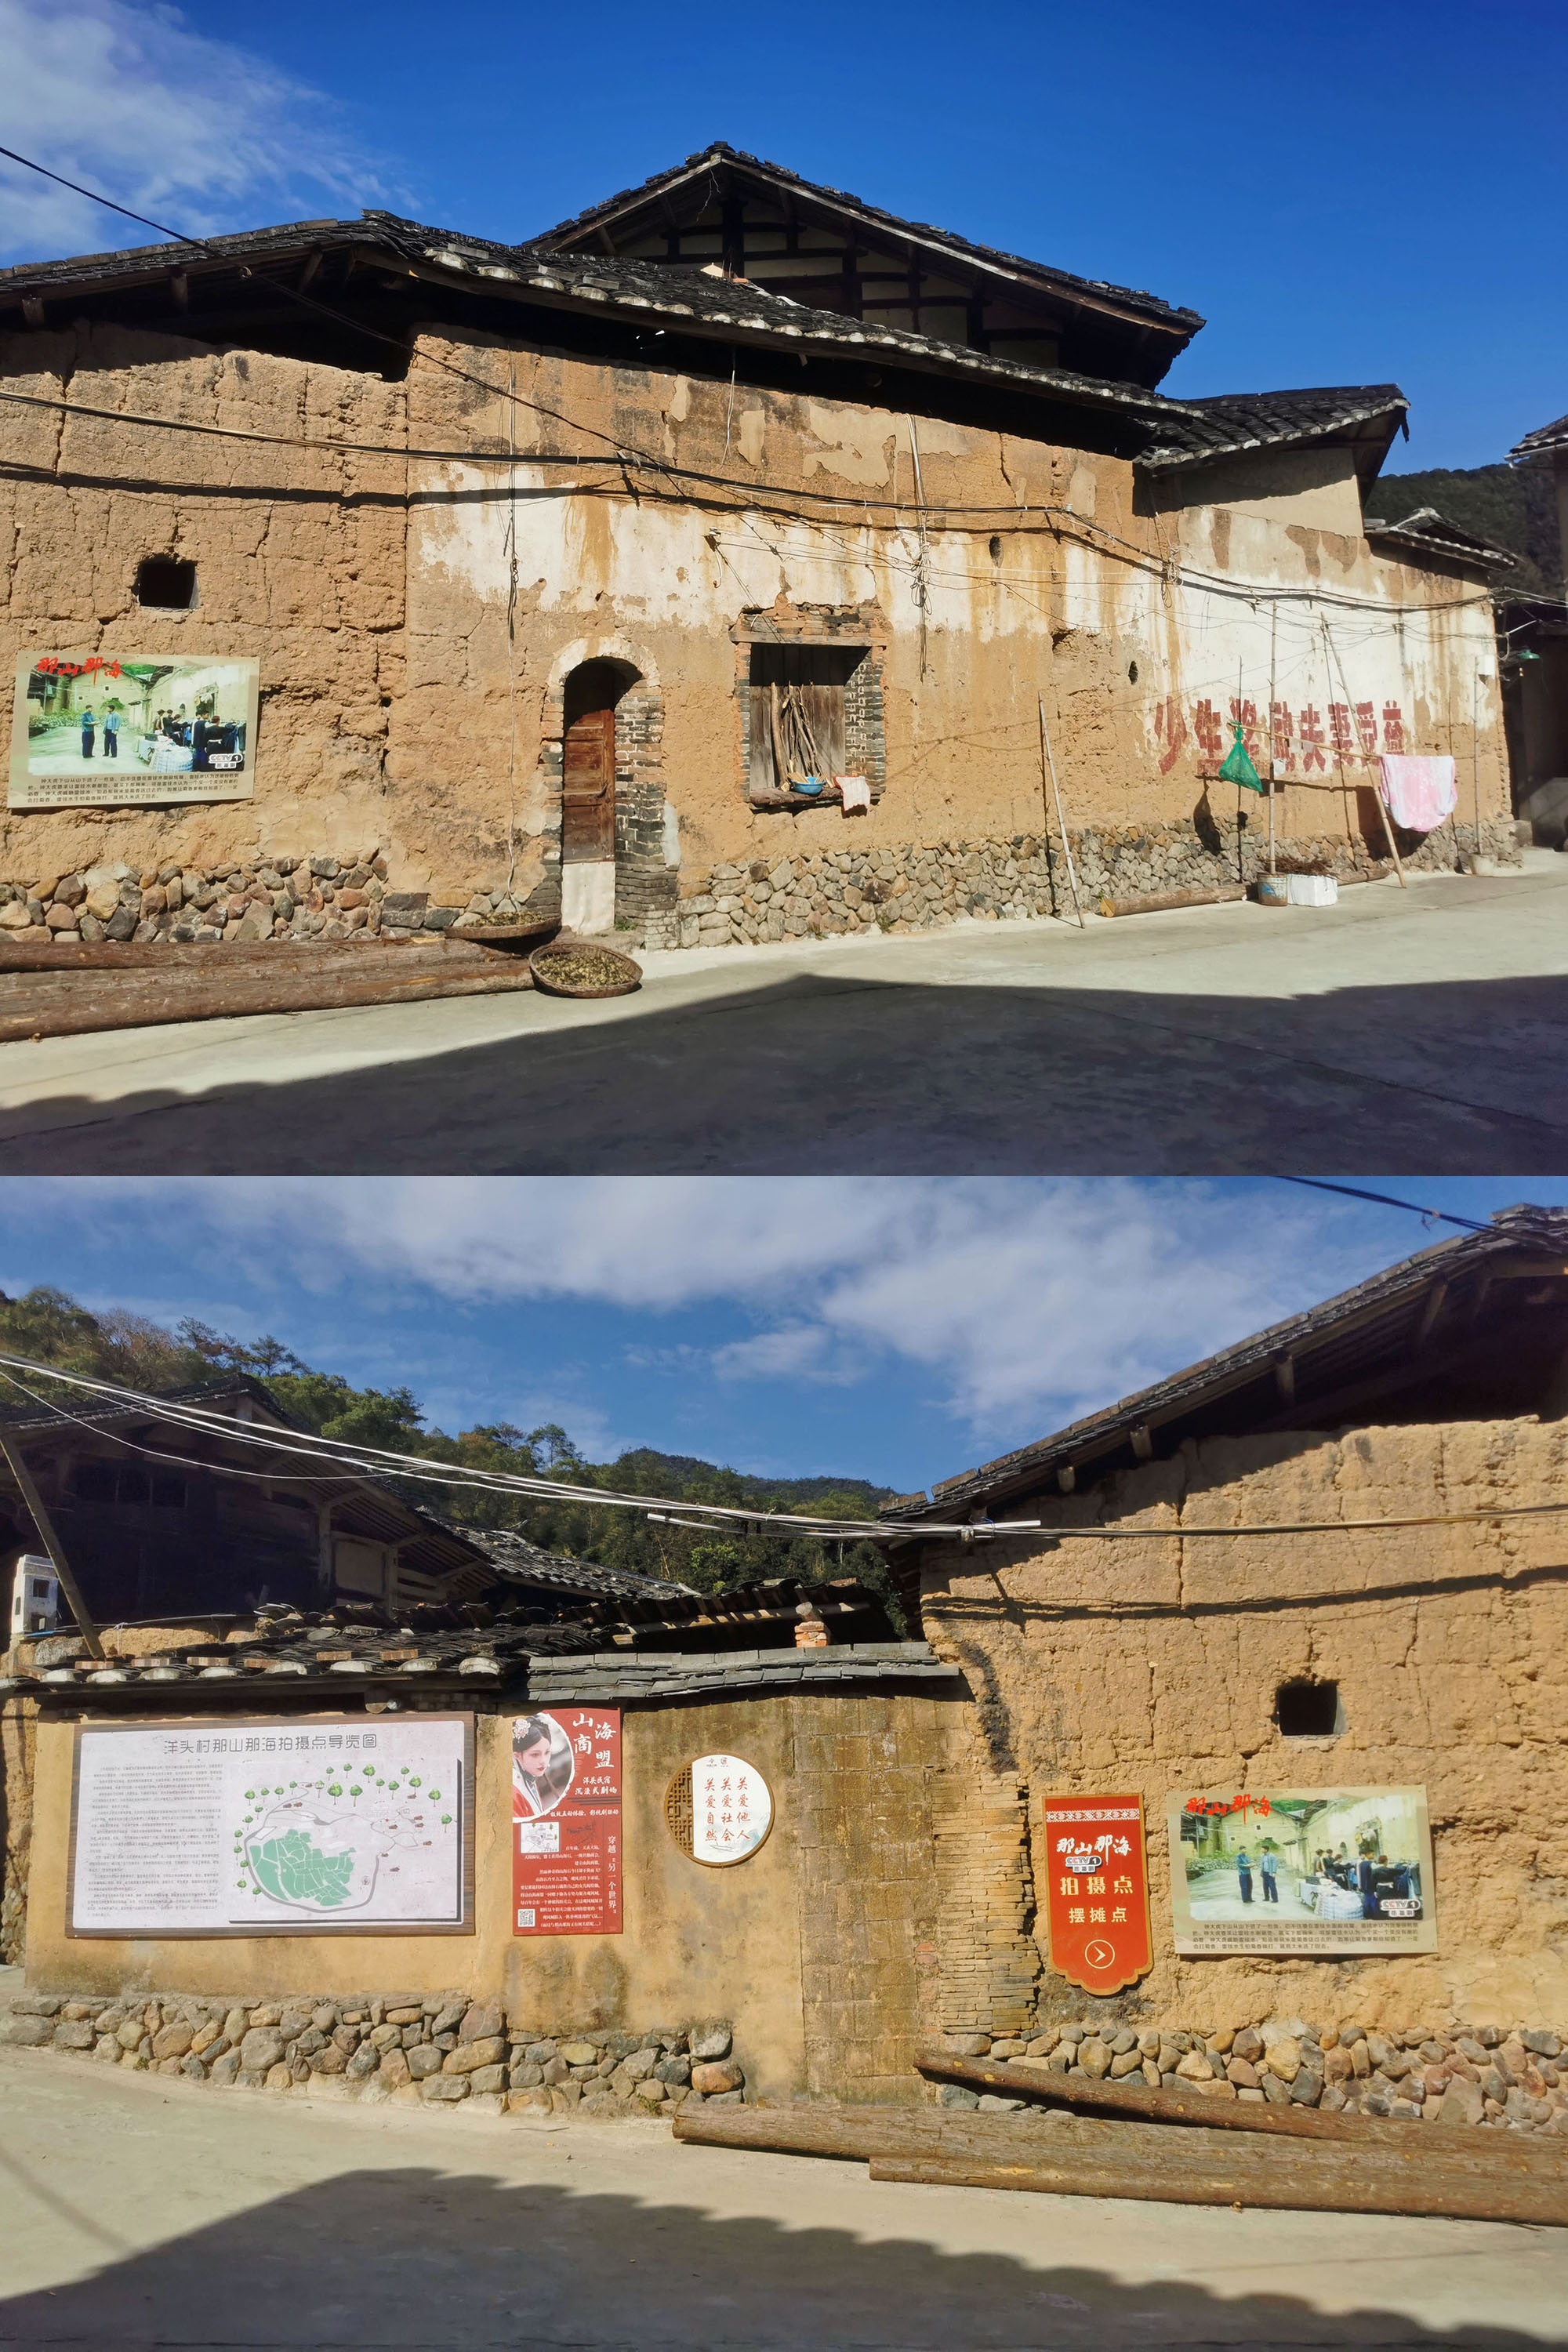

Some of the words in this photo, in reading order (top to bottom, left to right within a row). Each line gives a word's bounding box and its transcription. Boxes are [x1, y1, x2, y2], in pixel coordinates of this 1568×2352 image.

[163, 1733, 378, 1755] 洋头村那山那海拍摄点导览图
[704, 1777, 717, 1842] 关爱自然
[720, 1777, 735, 1842] 关爱社会
[736, 1776, 751, 1841] 关爱他人
[1057, 1834, 1132, 1865] 那山那海
[1060, 1875, 1134, 1896] 拍摄点
[1069, 1907, 1127, 1924] 摆摊点
